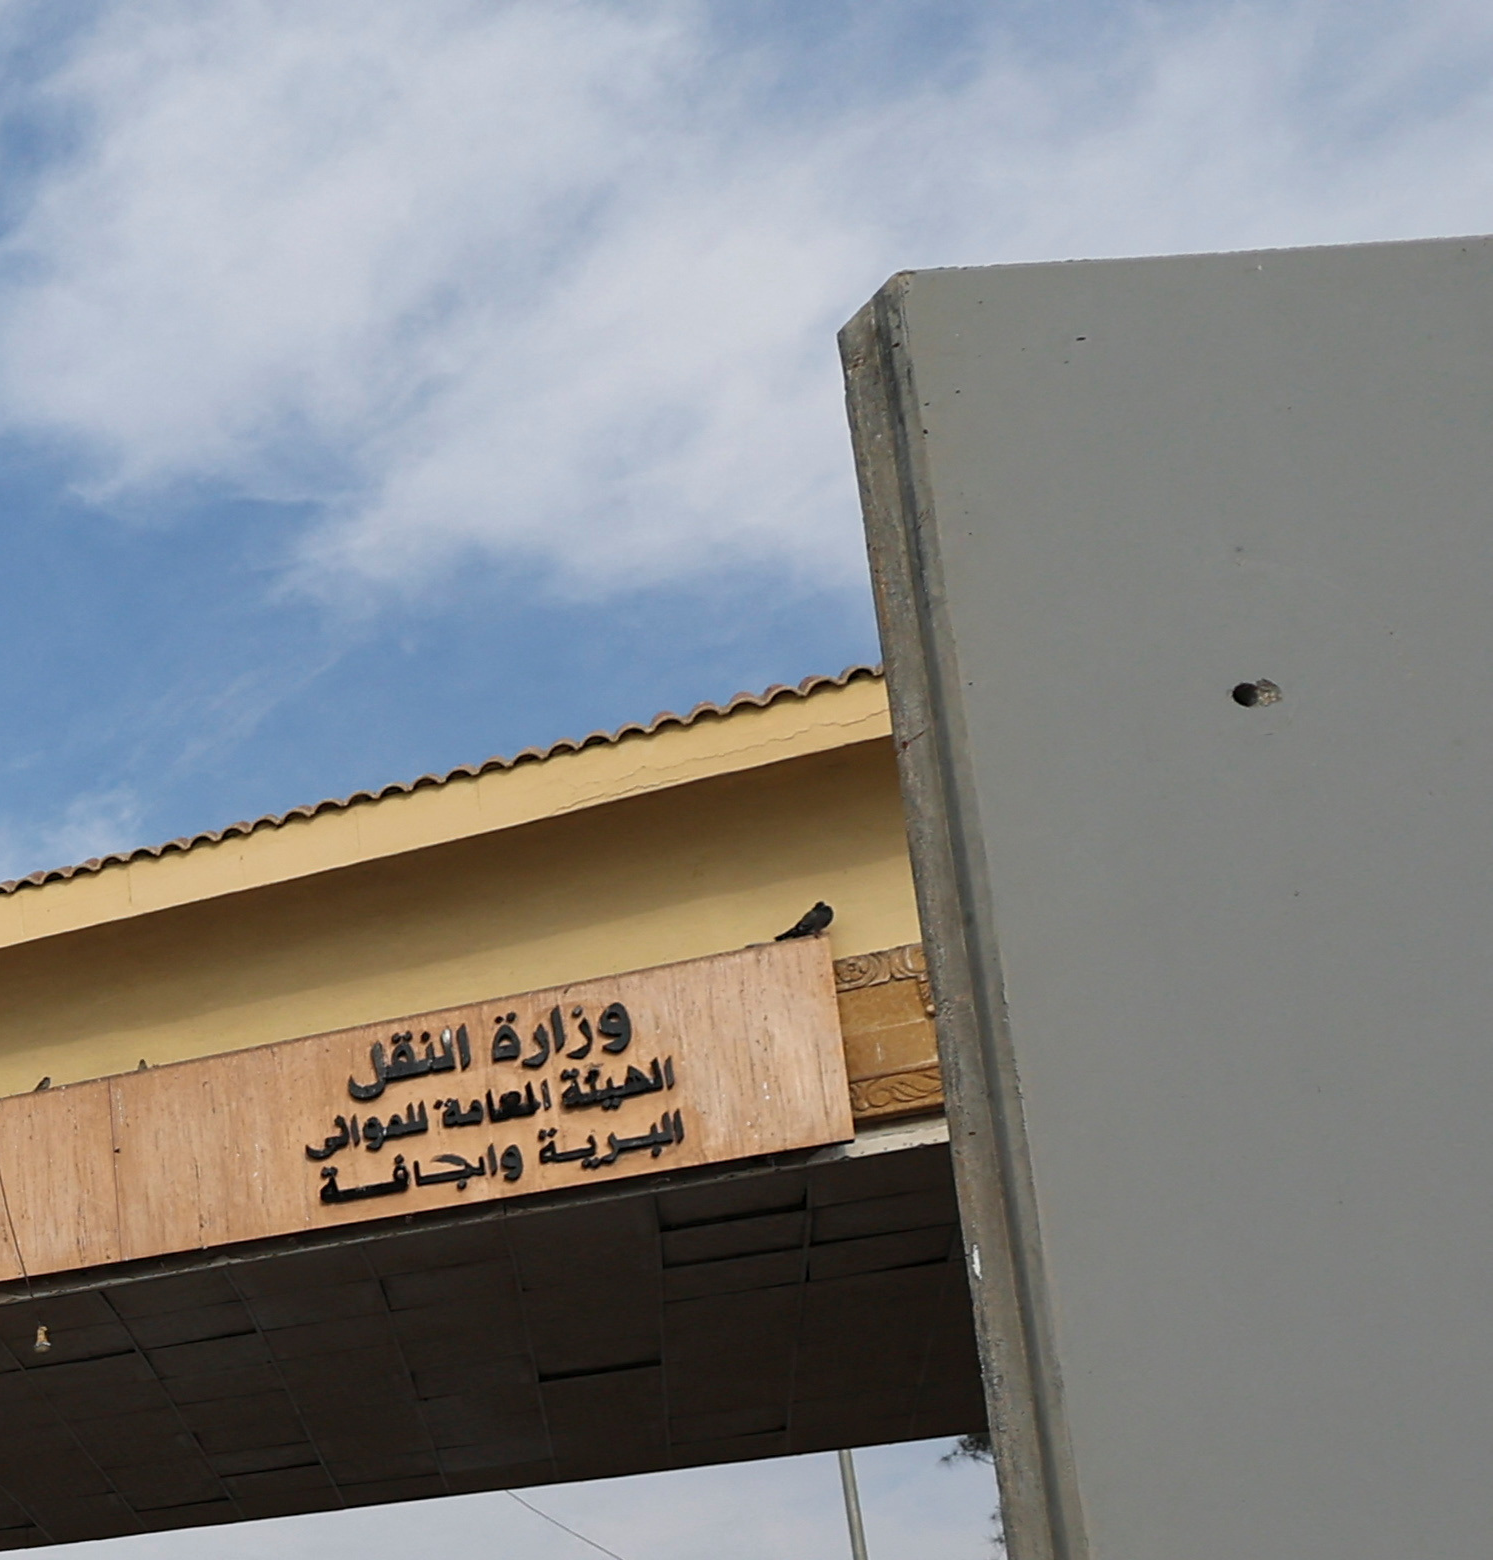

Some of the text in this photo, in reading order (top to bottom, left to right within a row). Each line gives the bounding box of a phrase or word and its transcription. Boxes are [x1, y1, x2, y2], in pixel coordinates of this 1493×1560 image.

[348, 1001, 632, 1100] وزارة النقل
[433, 1078, 551, 1129] العامة
[560, 1055, 675, 1111] الهيئة
[538, 1108, 685, 1169] البرية
